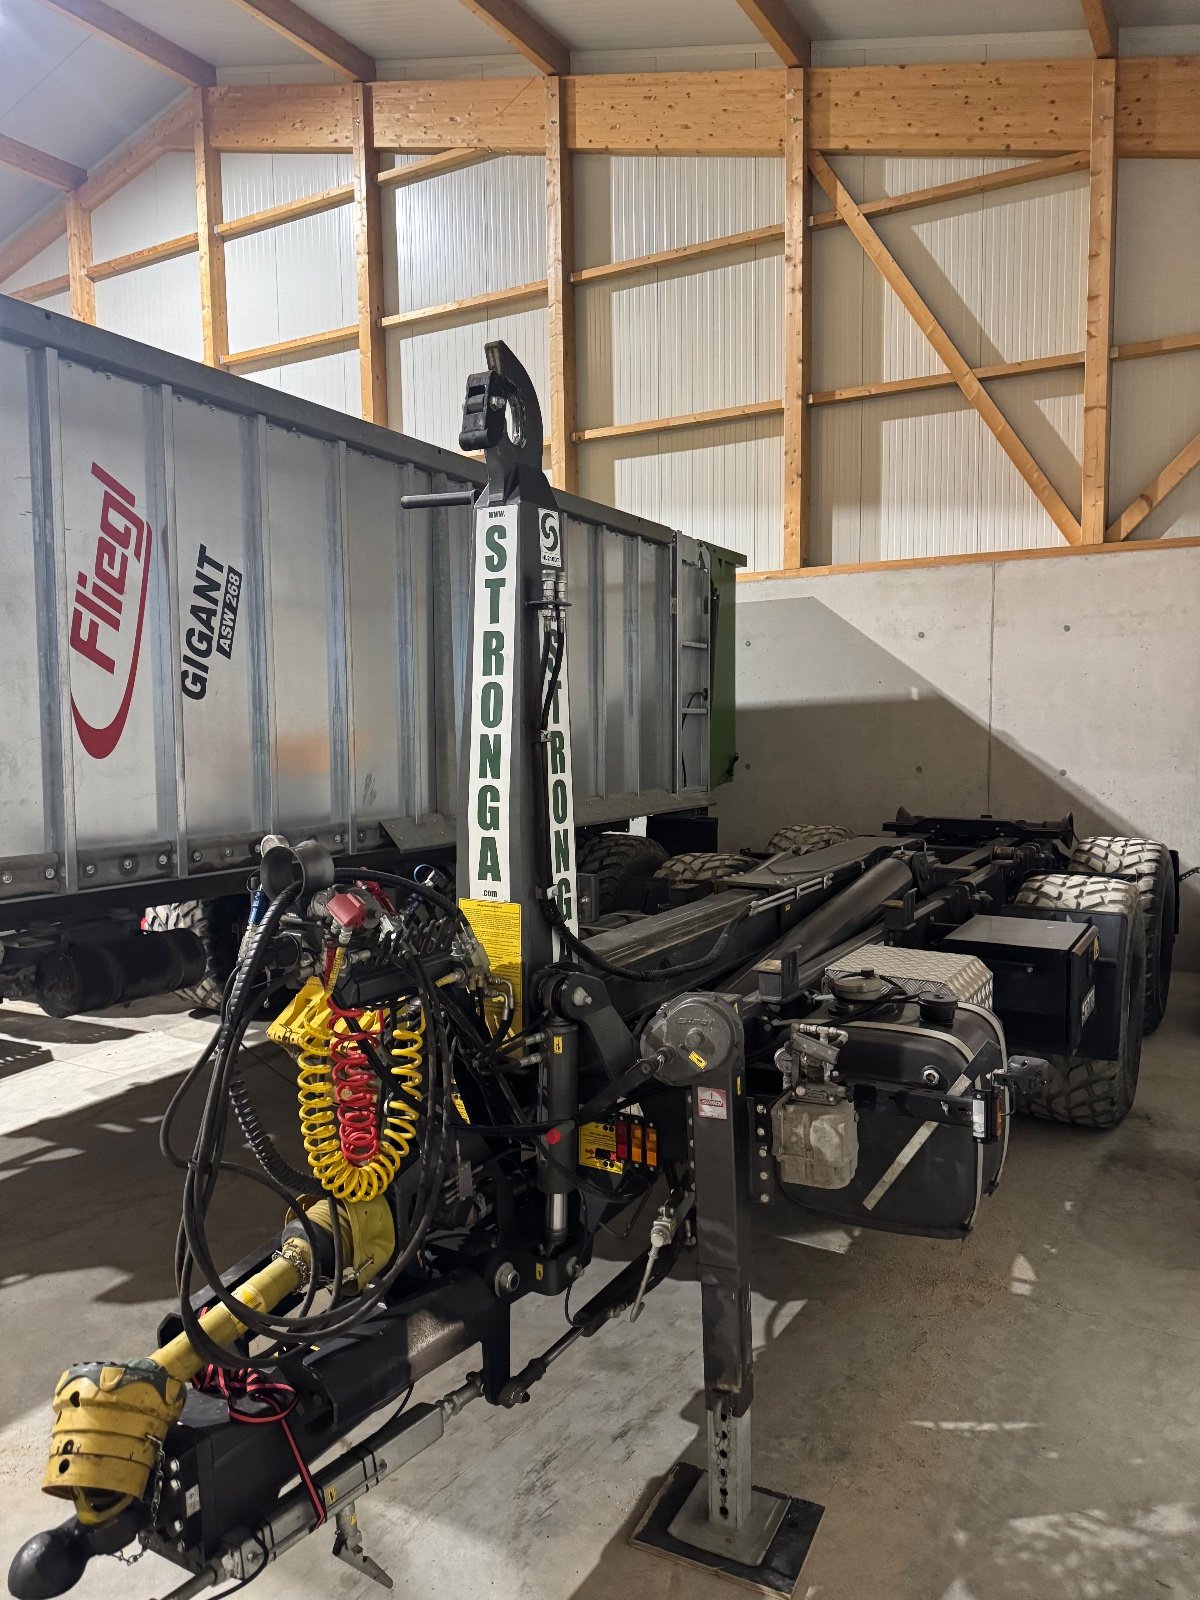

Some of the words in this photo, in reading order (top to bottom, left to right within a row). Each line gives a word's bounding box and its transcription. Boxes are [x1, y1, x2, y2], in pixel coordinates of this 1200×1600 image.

[70, 461, 145, 675] Fliegl
[225, 572, 240, 608] 268
[180, 543, 225, 701] GIGANT
[219, 608, 235, 653] ASW
[477, 524, 507, 882] STRONGA
[482, 889, 498, 898] .com
